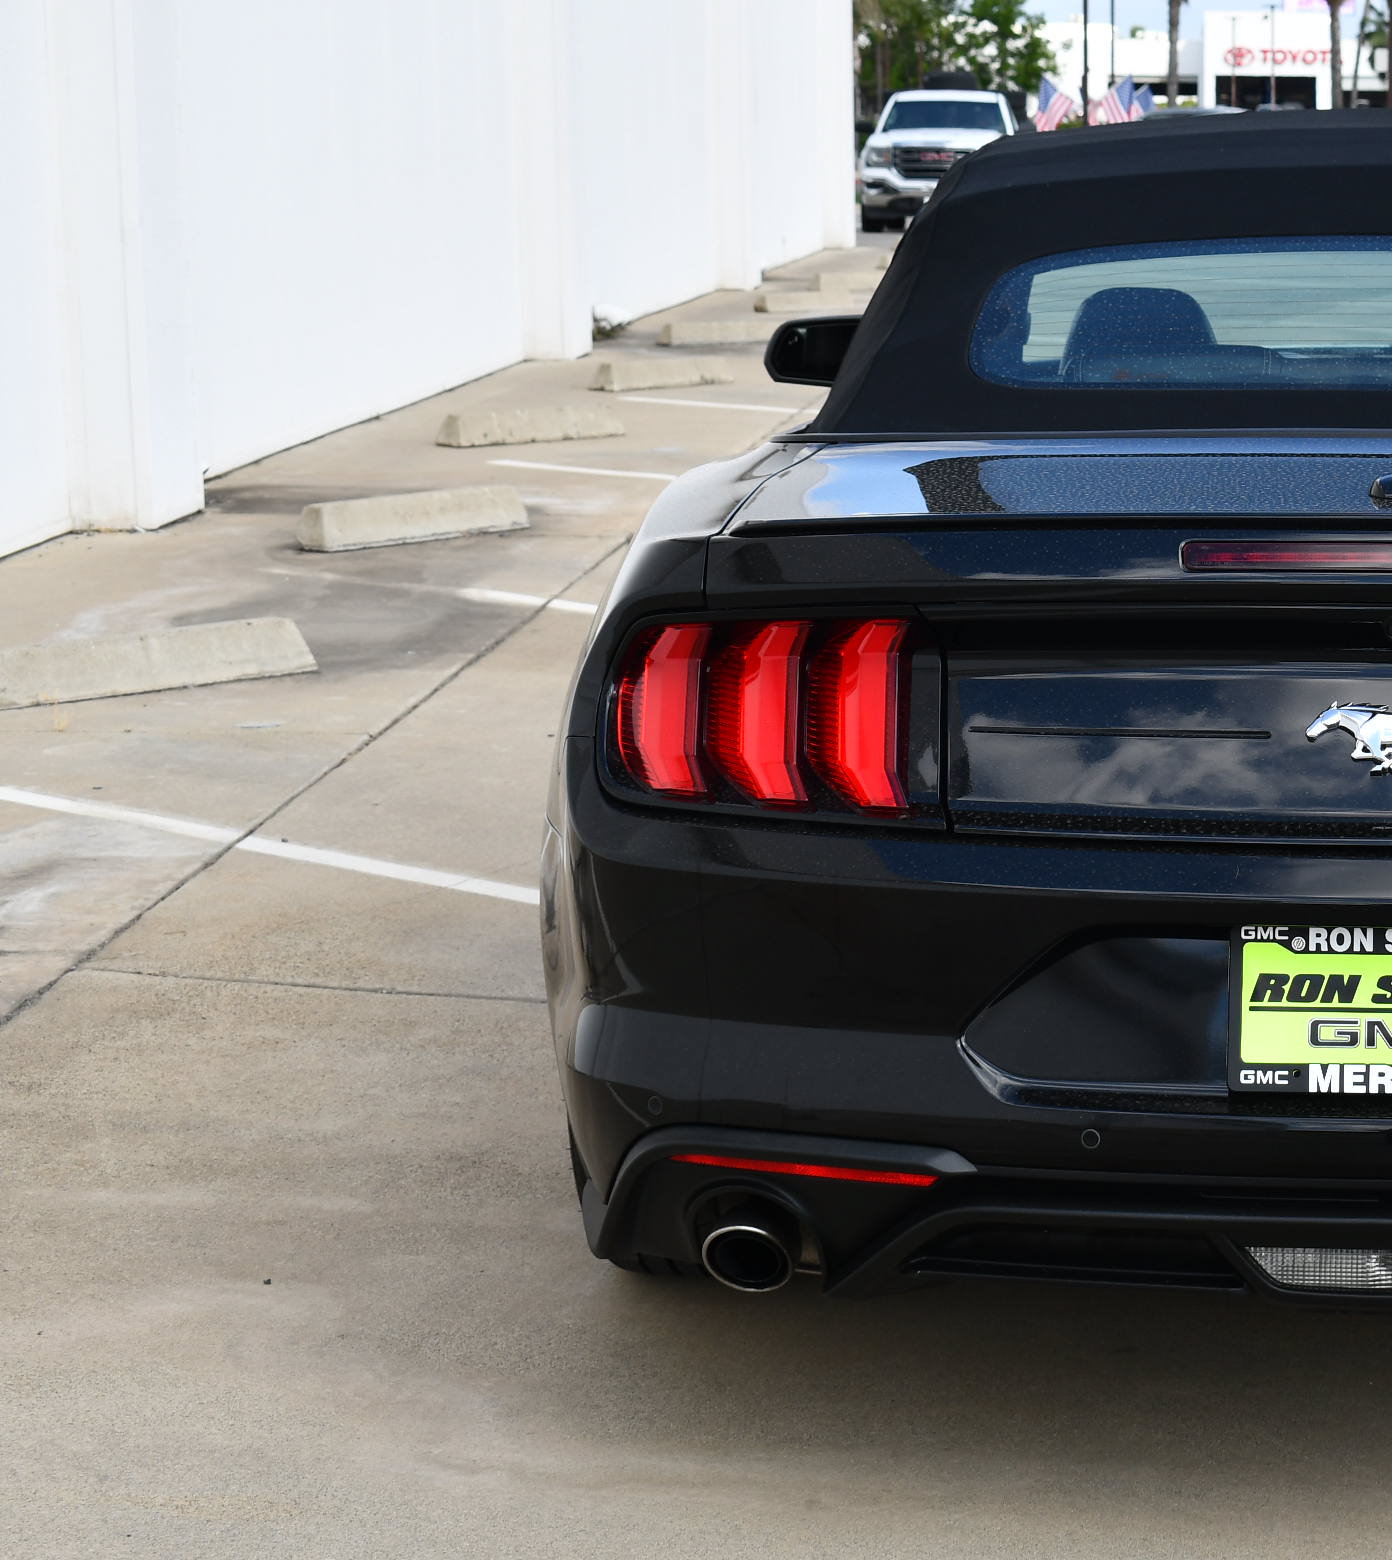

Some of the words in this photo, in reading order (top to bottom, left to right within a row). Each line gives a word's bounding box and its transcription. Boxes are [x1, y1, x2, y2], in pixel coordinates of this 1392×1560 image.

[1261, 49, 1343, 65] TOYOT
[1240, 926, 1289, 941] GMC
[1308, 927, 1374, 953] RON
[1250, 973, 1362, 1003] RON
[1239, 1069, 1289, 1086] GMC
